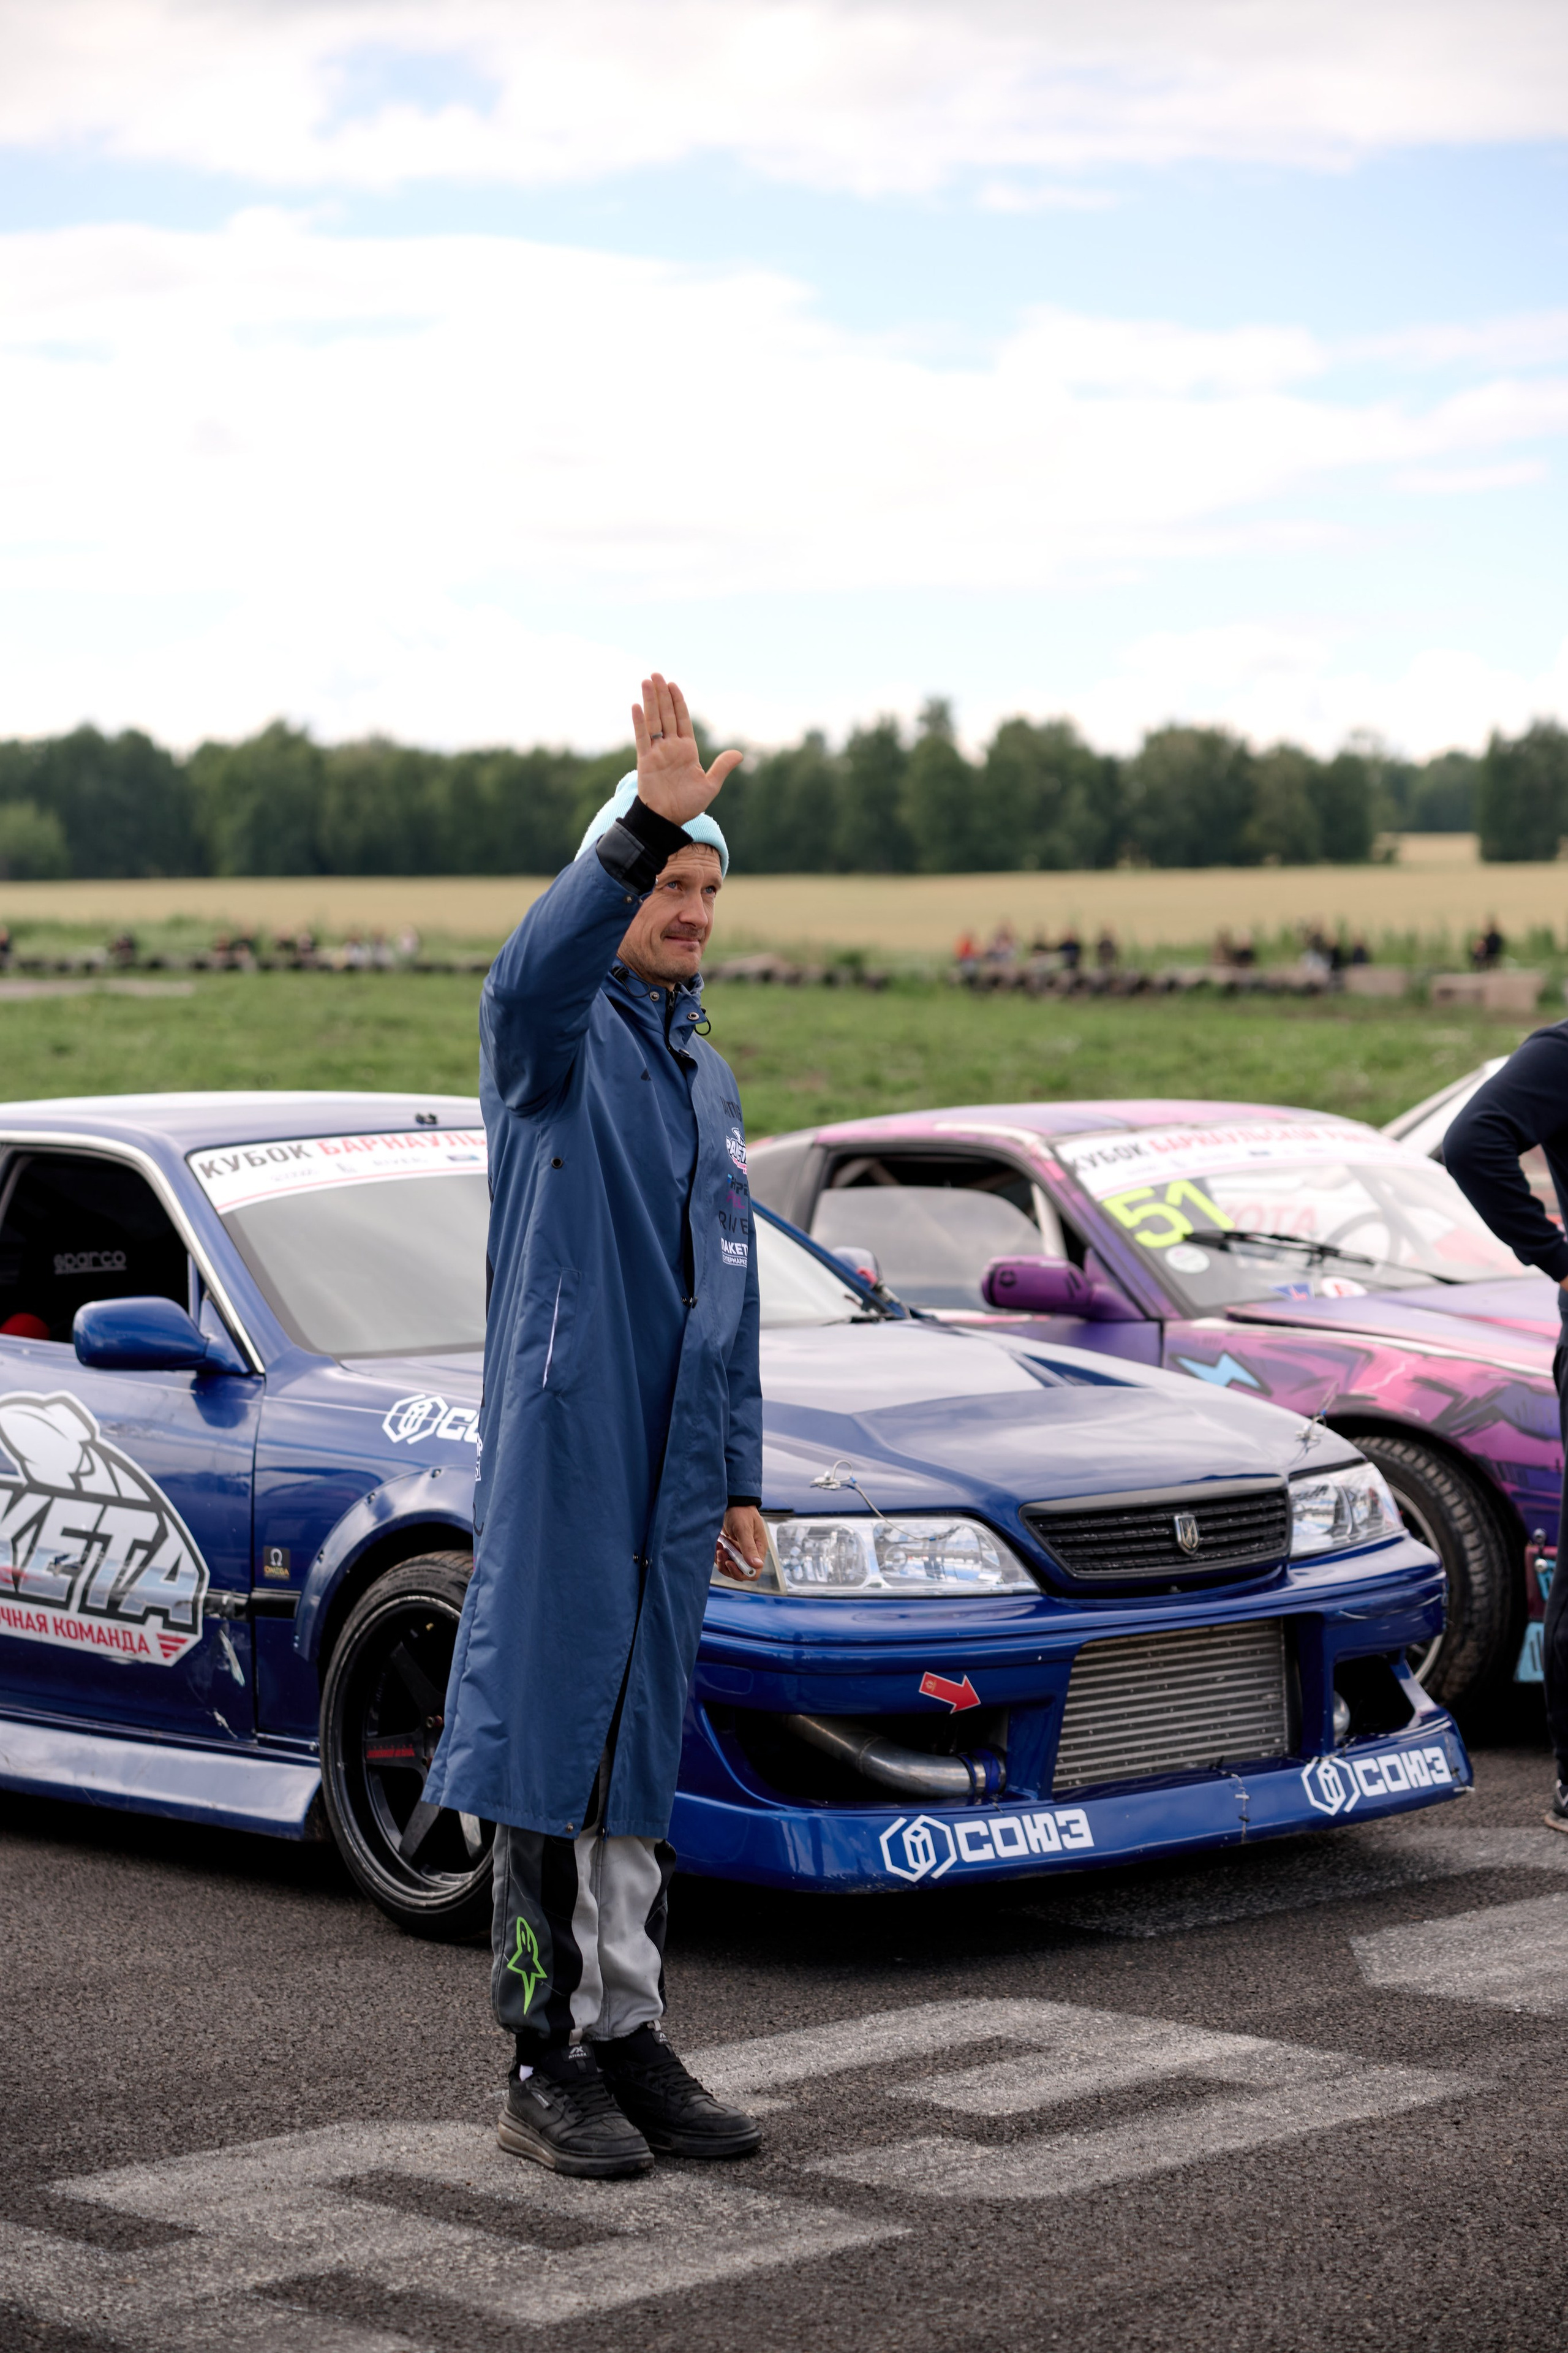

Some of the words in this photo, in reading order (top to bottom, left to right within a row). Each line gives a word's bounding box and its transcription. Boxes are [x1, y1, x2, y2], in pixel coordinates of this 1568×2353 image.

[198, 1144, 313, 1179] КУБОК
[1102, 1179, 1236, 1248] 51
[721, 1237, 748, 1256] ПАКЕТ
[0, 1606, 48, 1634] ЧНАЯ
[53, 1615, 151, 1655] КОМАНДА
[1351, 1746, 1453, 1797] СОЮЗ
[954, 1808, 1095, 1863] СОЮЗ
